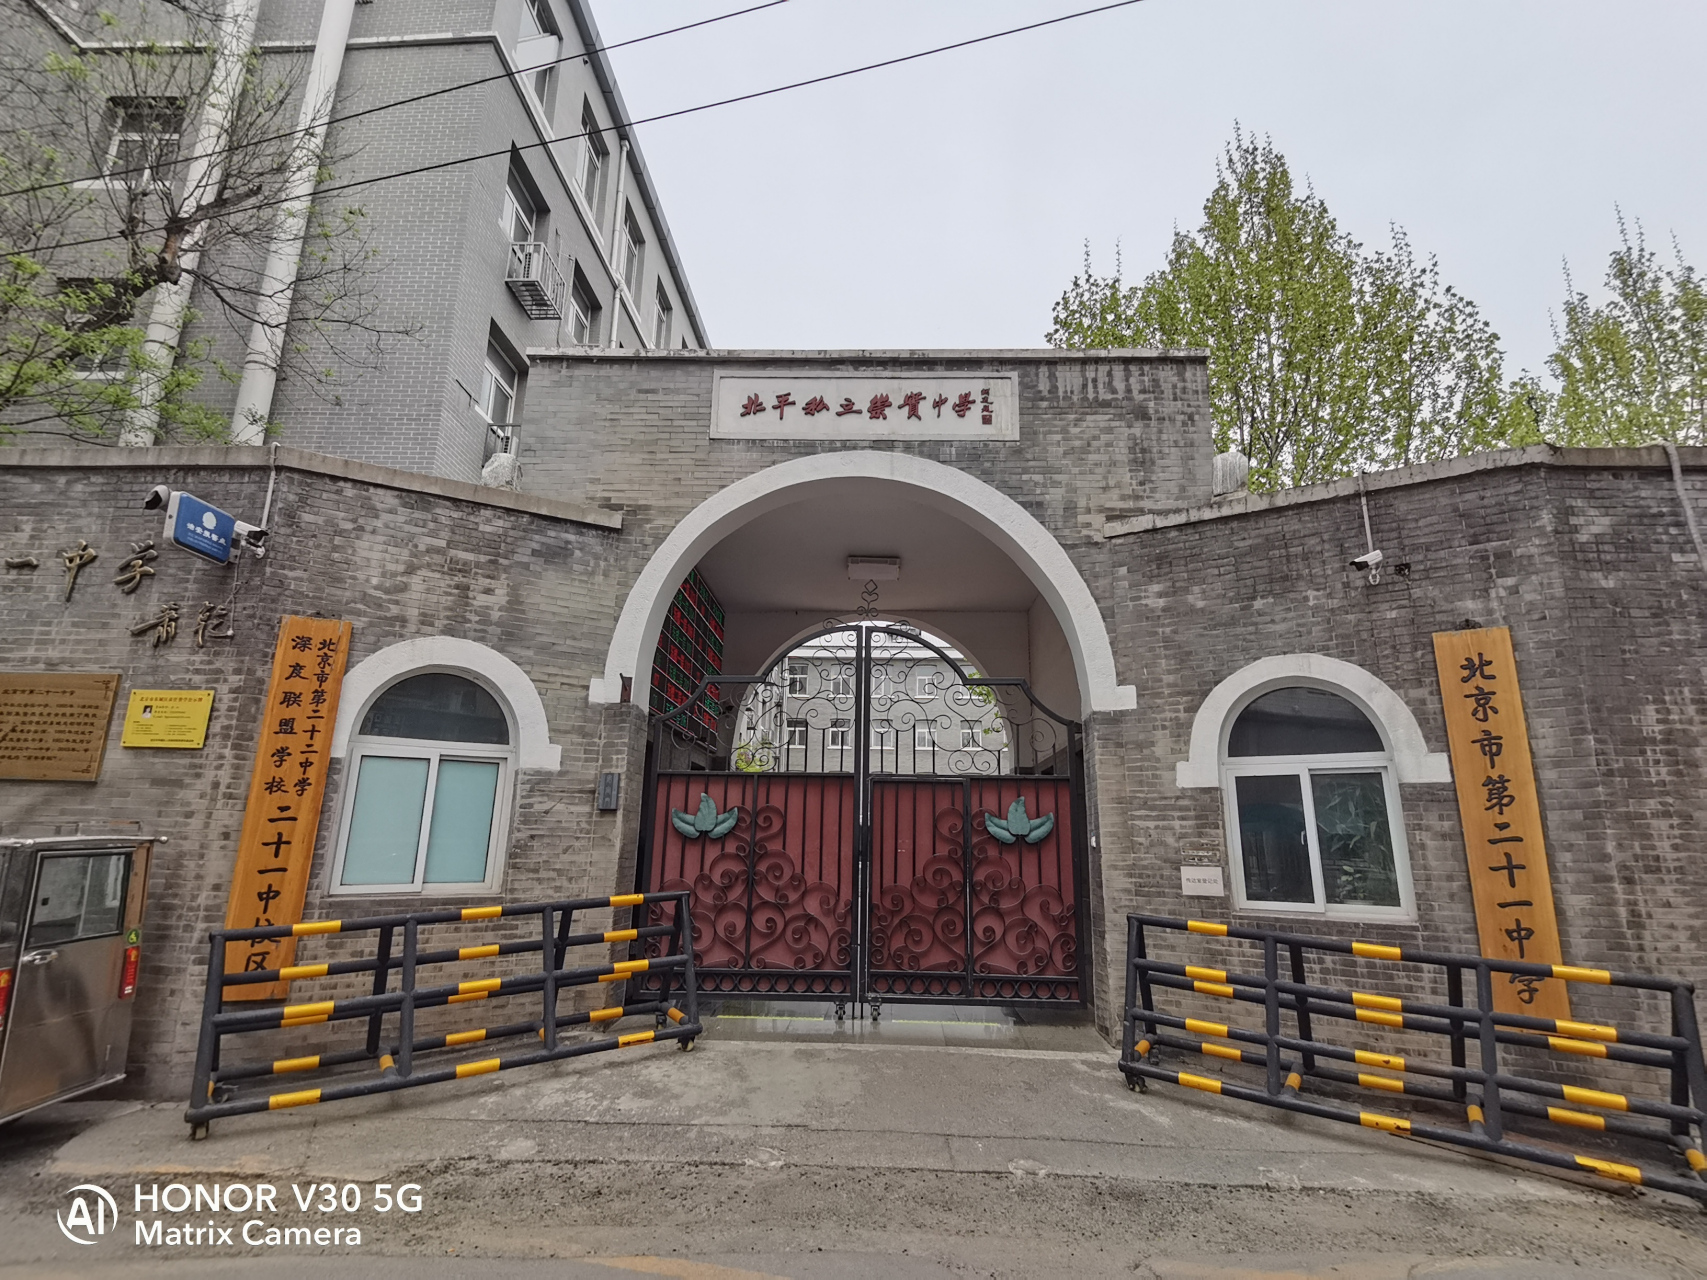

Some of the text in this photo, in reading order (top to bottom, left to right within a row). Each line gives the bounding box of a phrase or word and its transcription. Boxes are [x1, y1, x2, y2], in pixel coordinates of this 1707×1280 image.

[740, 391, 976, 421] 北平私立崇實中學
[263, 635, 313, 795] 深度联盟学校
[293, 638, 337, 797] 北京市第二十二中学
[1460, 655, 1545, 1005] 北京市第二十一中学
